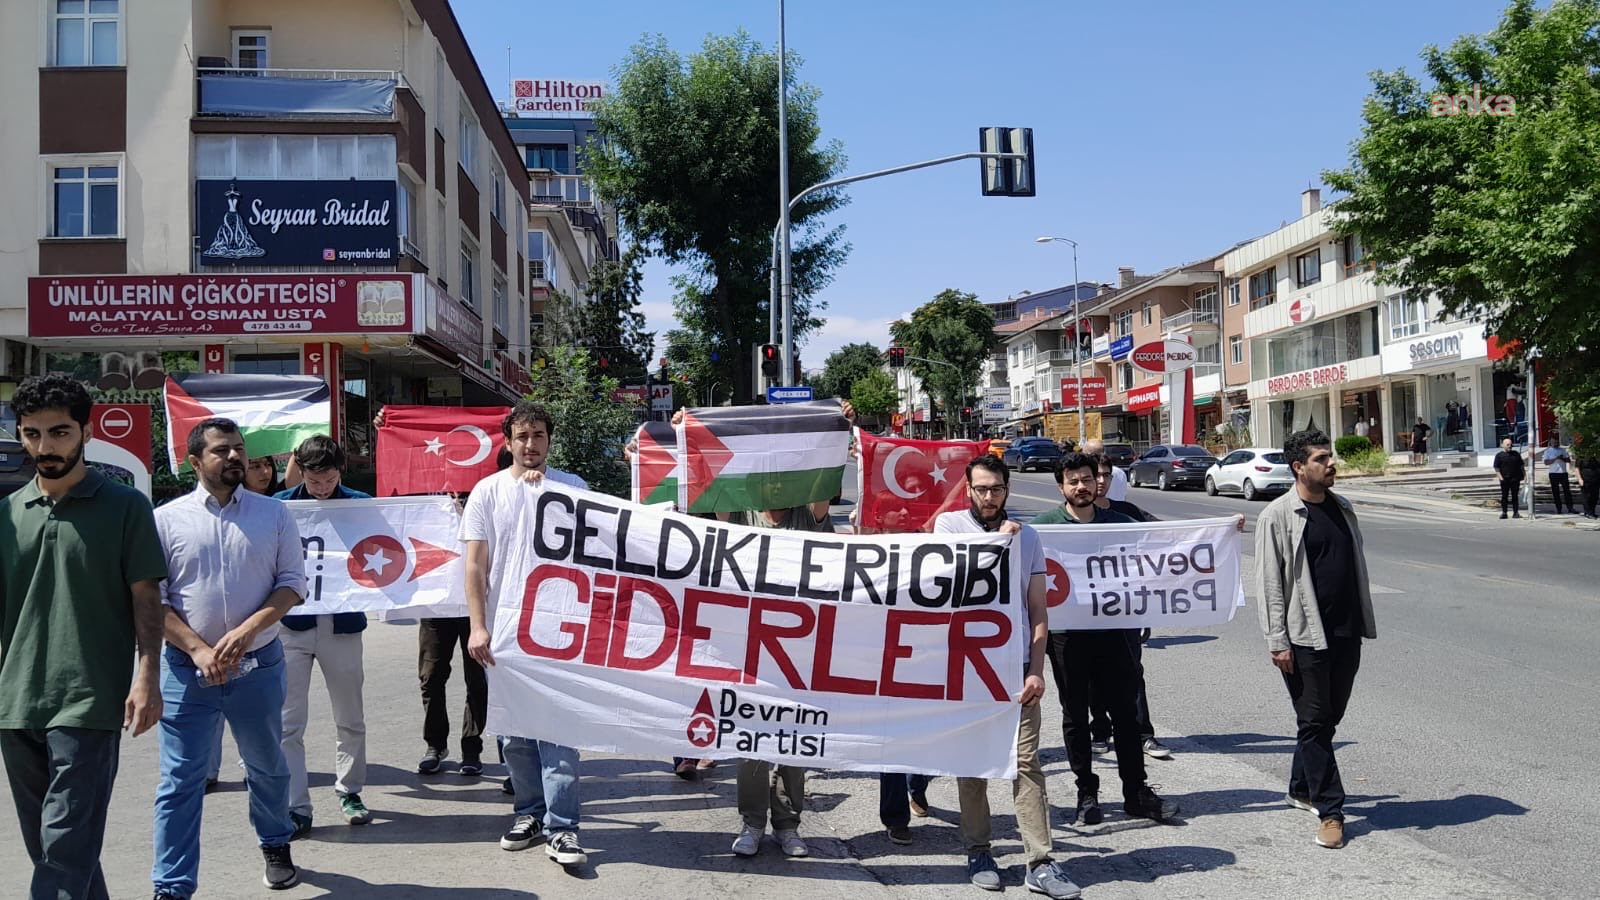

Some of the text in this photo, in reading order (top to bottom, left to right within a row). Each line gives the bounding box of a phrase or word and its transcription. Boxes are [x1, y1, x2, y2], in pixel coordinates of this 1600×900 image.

[534, 80, 602, 98] Hilton
[515, 98, 572, 111] Garden
[248, 198, 391, 234] Seyran Bridal
[338, 248, 391, 261] seyranbridal
[48, 279, 175, 306] ÜNLÜLERİN
[68, 308, 327, 322] MALATYALI OSMAN USTA
[251, 322, 301, 330] 478 43 44
[1166, 351, 1193, 361] PERDE
[1409, 334, 1460, 359] sesam
[1268, 364, 1346, 393] PERDORE PERDE
[719, 688, 829, 726] Devrim
[716, 718, 827, 757] Partisi
